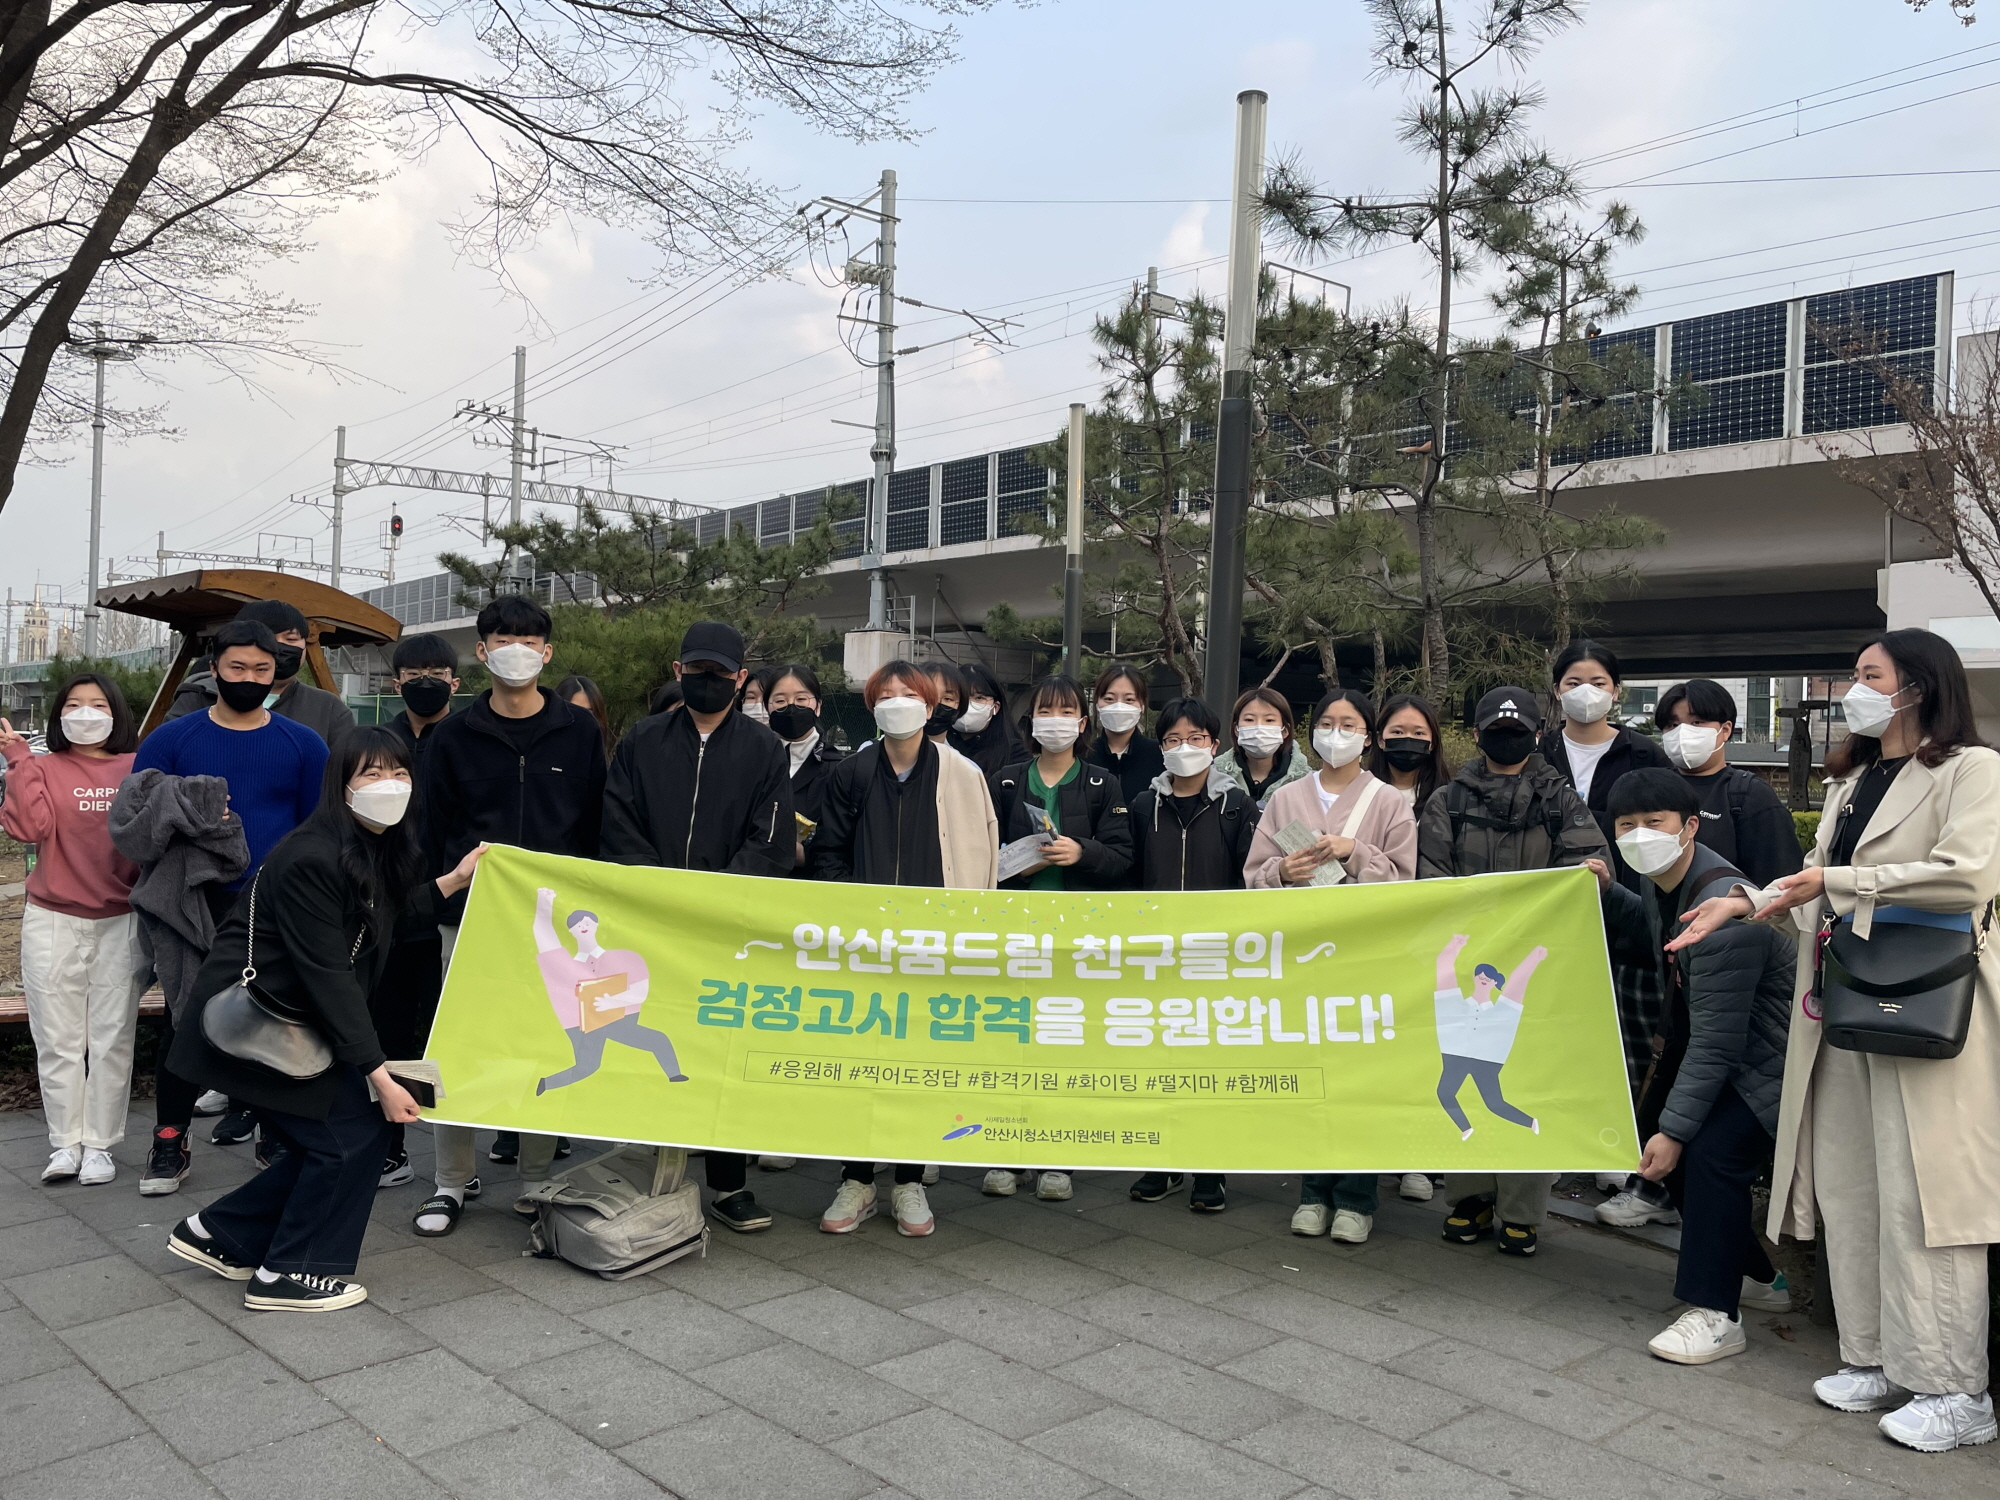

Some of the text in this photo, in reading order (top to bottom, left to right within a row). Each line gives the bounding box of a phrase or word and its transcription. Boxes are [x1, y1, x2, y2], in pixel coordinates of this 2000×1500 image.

[792, 923, 1283, 980] 안산꿈드림 친구들의
[697, 979, 1396, 1046] 검정고시 합격을 응원합니다!
[769, 1060, 1299, 1093] #응원해 #찍어도정답 #합격기원 #화이팅 #떨지마 #함께해
[984, 1128, 1160, 1145] 안산시청소년지원센터 꿈드림
